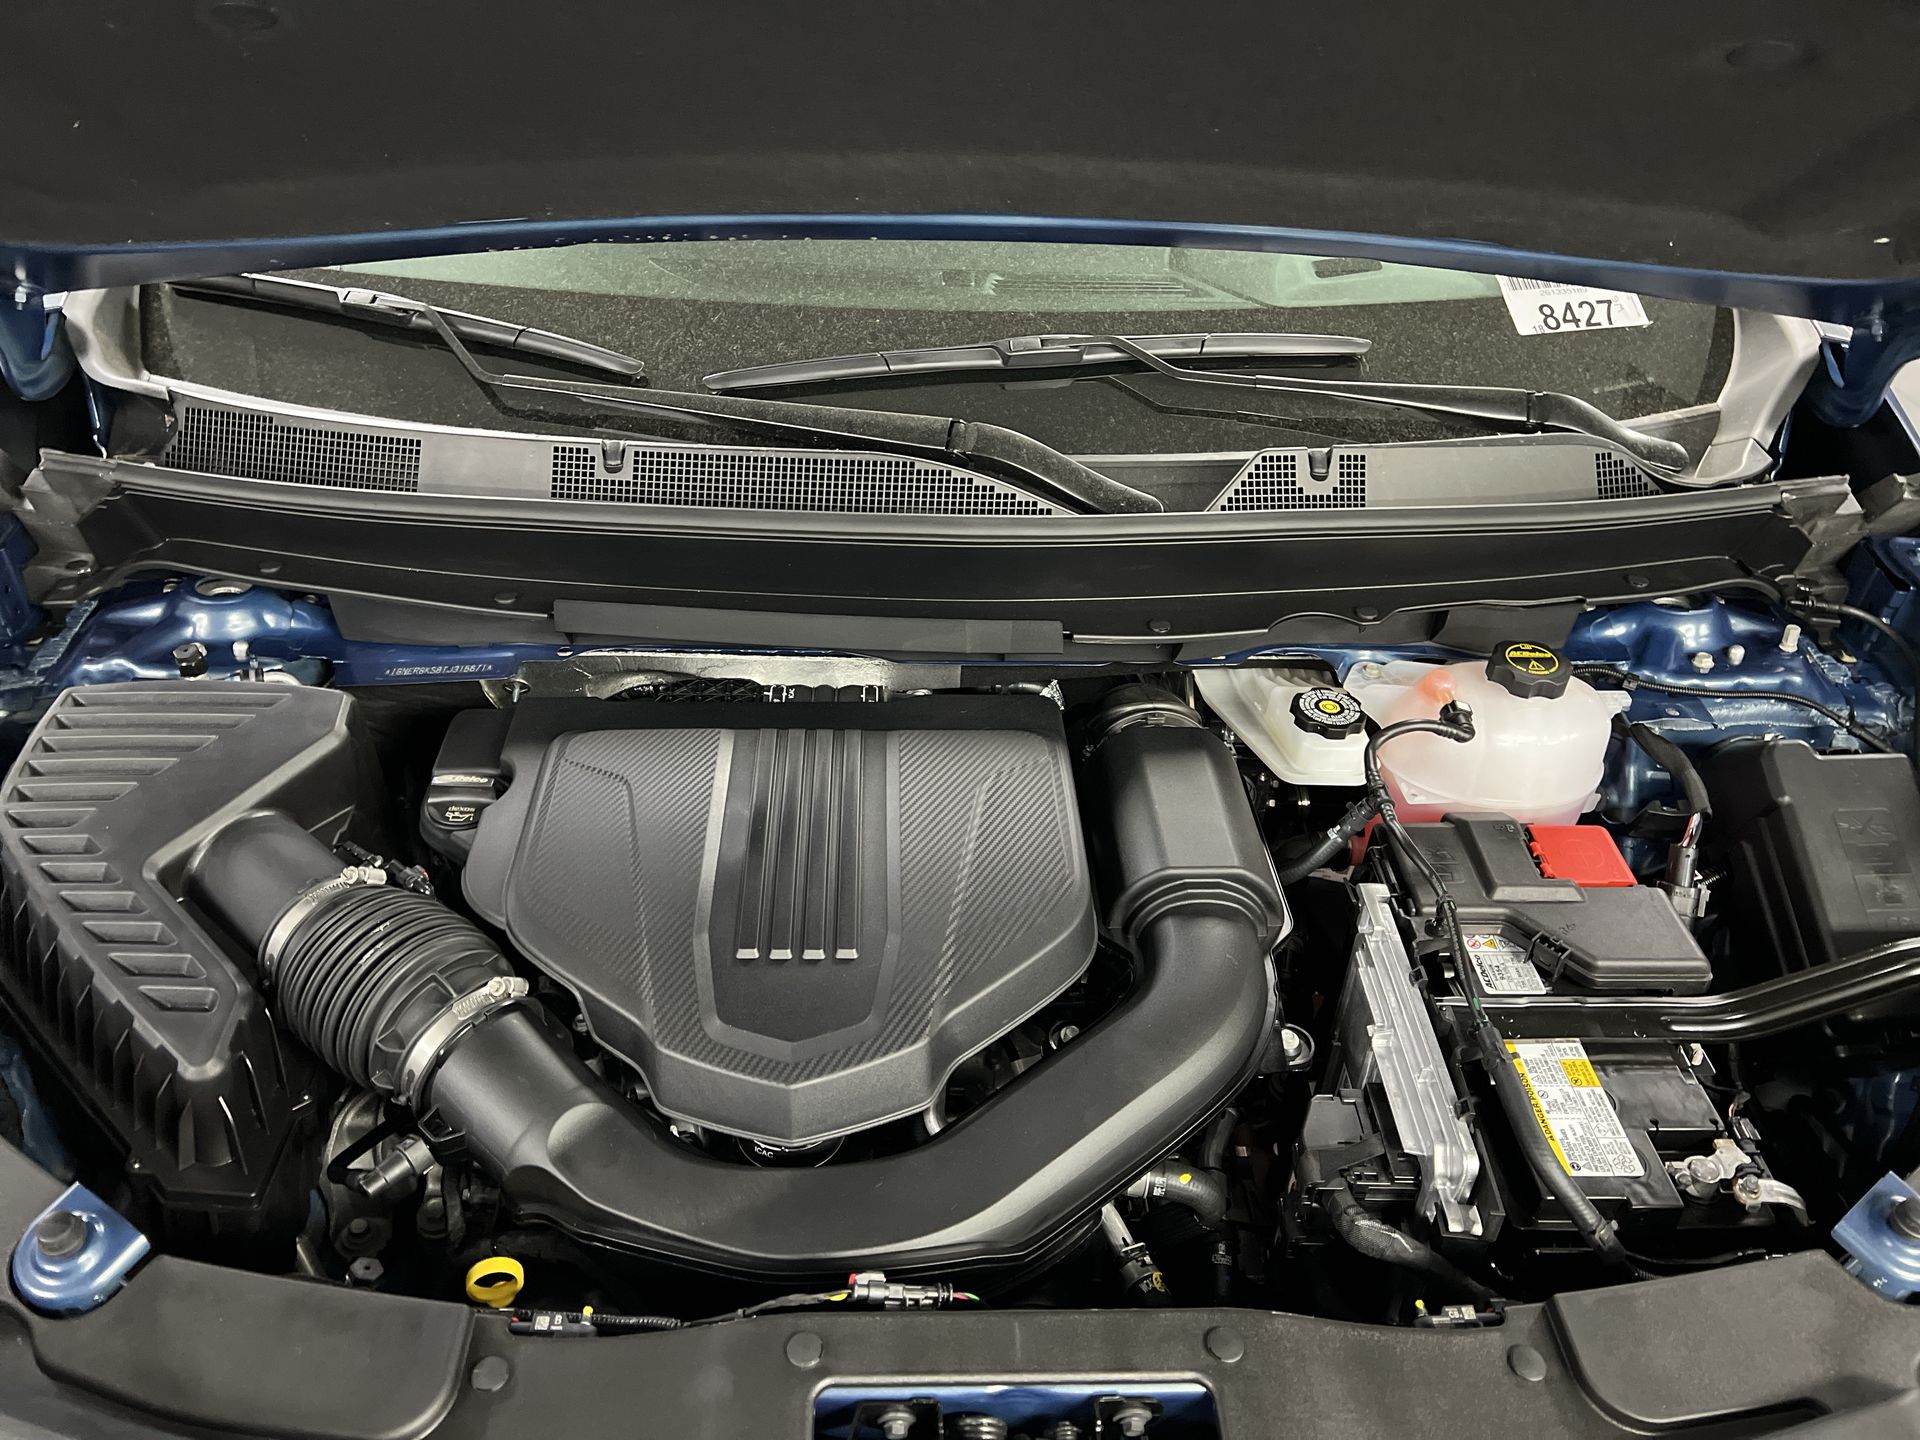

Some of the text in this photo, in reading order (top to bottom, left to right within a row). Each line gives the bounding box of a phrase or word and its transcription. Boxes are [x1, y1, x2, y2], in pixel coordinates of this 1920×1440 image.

[1538, 299, 1614, 331] 8427
[1532, 324, 1545, 334] 18
[448, 805, 476, 813] dexos
[1474, 954, 1495, 989] ACDelco
[554, 1314, 562, 1324] B
